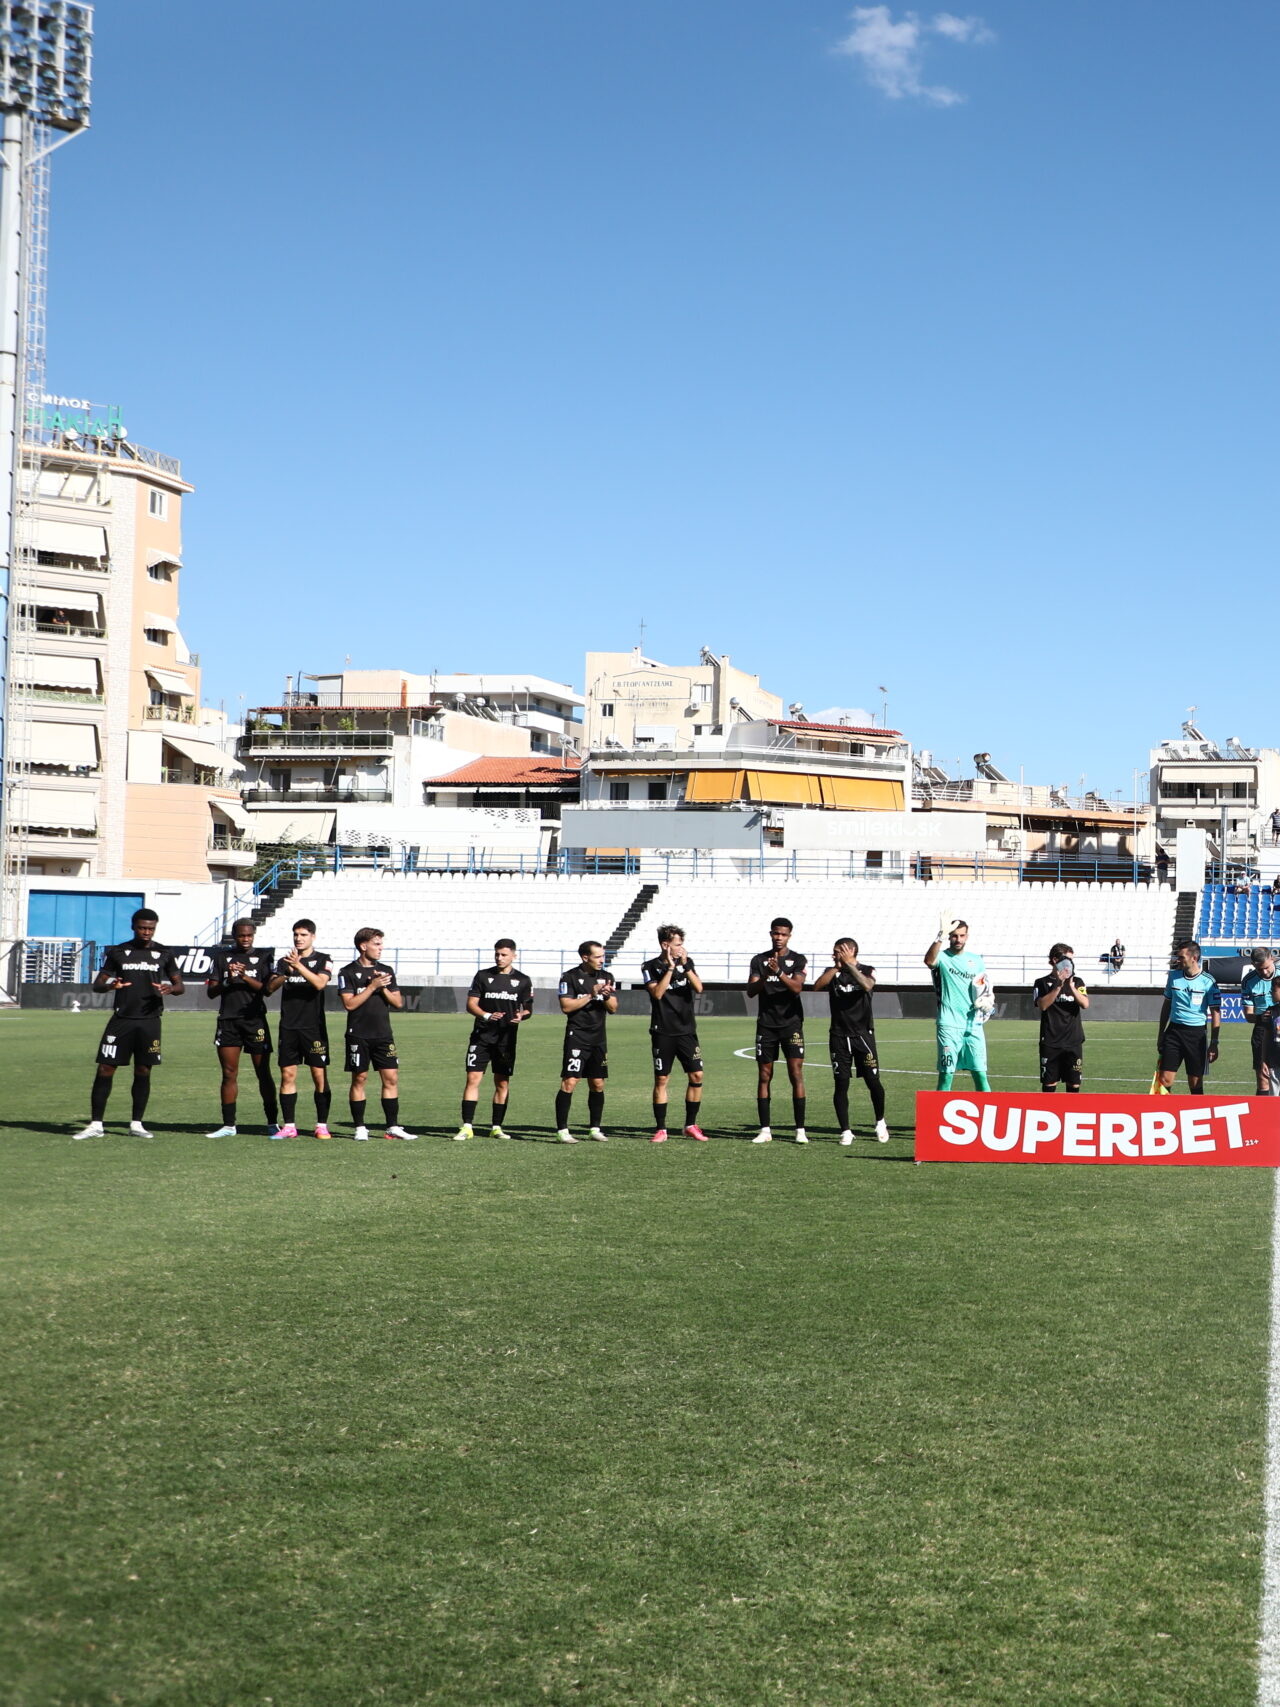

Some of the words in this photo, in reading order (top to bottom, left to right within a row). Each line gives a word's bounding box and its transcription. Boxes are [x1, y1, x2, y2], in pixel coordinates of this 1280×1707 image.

[122, 961, 159, 972] novibet
[484, 990, 518, 1002] novibet
[102, 1044, 117, 1058] 44
[567, 1058, 581, 1072] 29
[938, 1099, 1250, 1157] SUPERBET
